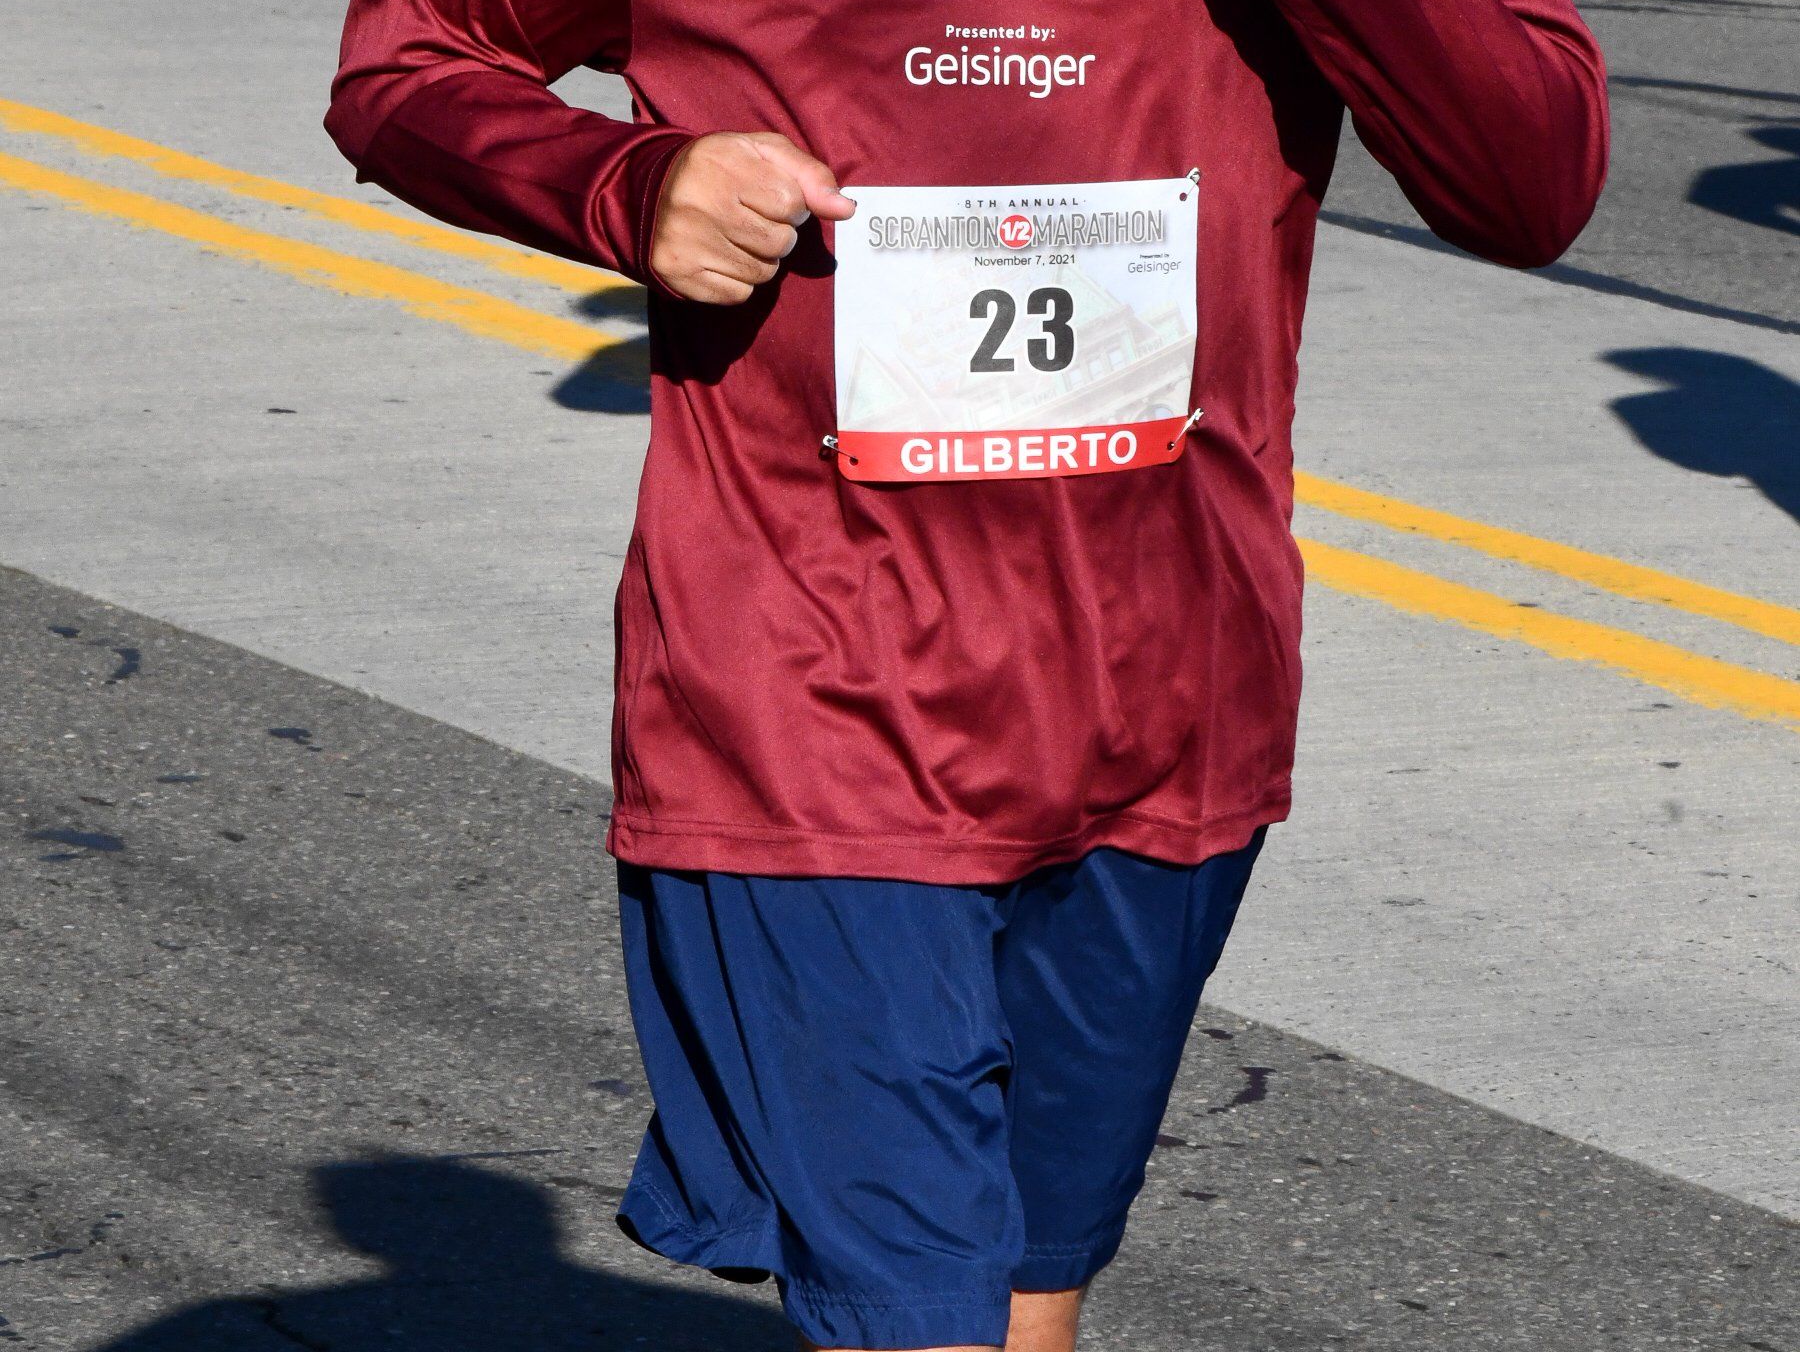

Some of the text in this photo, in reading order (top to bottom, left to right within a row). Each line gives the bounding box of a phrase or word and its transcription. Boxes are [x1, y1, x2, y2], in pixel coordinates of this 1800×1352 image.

[945, 25, 1056, 41] Presented by:
[904, 45, 1096, 99] Geisinger
[964, 197, 1079, 209] 8TH ANNUAL
[868, 210, 1163, 248] SCRANTON 1/2 MARATHON
[974, 253, 1076, 267] November 7, 2021
[1127, 259, 1182, 275] Geisinger
[969, 287, 1075, 374] 23
[899, 430, 1138, 475] GILBERTO
